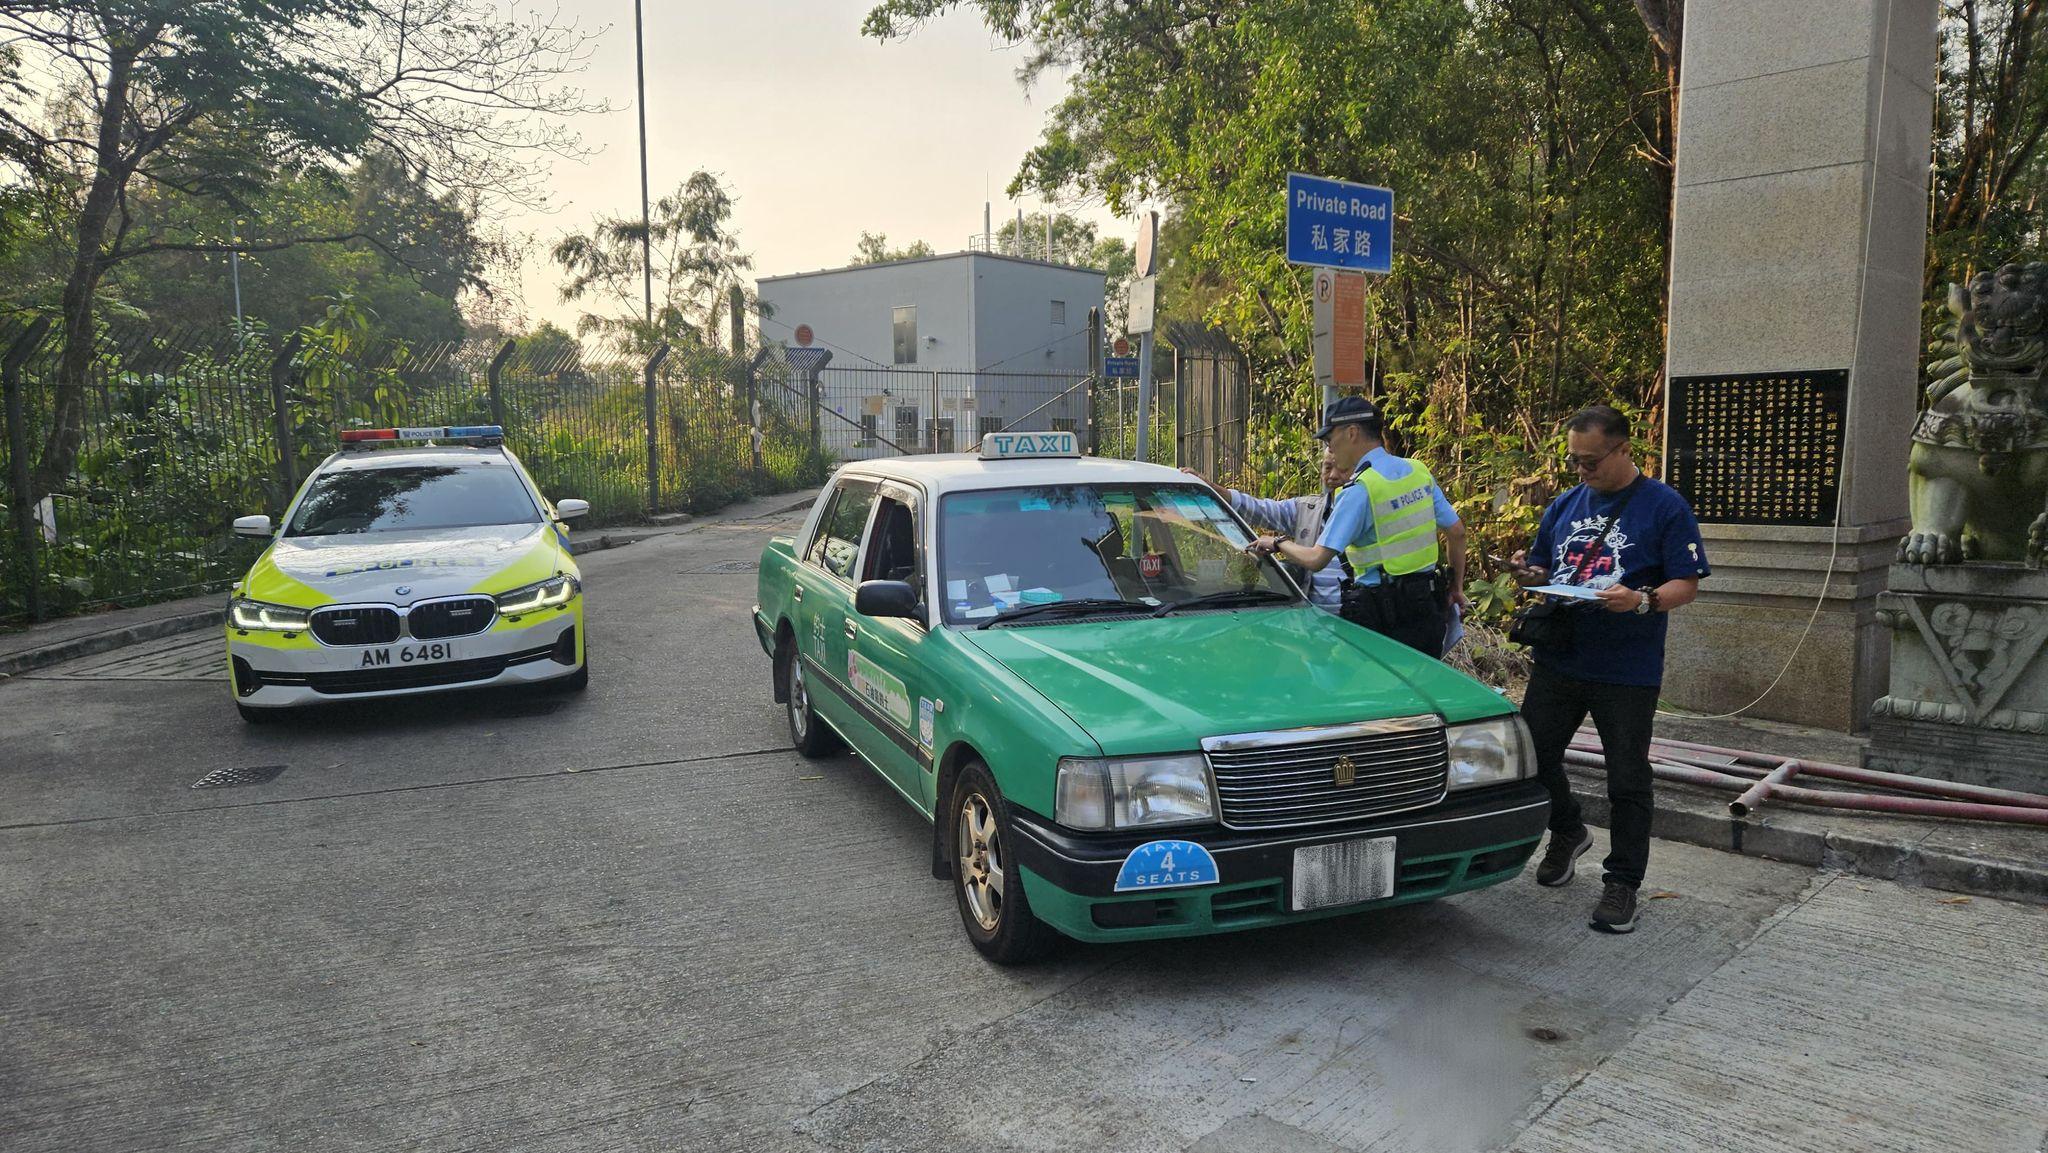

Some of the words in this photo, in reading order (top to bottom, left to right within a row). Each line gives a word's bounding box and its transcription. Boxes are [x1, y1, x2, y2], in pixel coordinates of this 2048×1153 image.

[1297, 189, 1347, 215] Private
[1351, 198, 1386, 221] Road
[1311, 223, 1372, 257] 私家路
[994, 435, 1071, 453] TAXI
[1400, 489, 1424, 506] POLICE
[362, 559, 448, 571] POLICE
[1142, 559, 1160, 571] TAXI
[813, 612, 826, 637] 的士
[361, 648, 390, 668] AM
[400, 645, 452, 663] 6481
[812, 635, 826, 664] TAXI
[1141, 842, 1194, 857] TAXI
[1160, 851, 1176, 872] 4
[1136, 870, 1200, 885] SEATS
